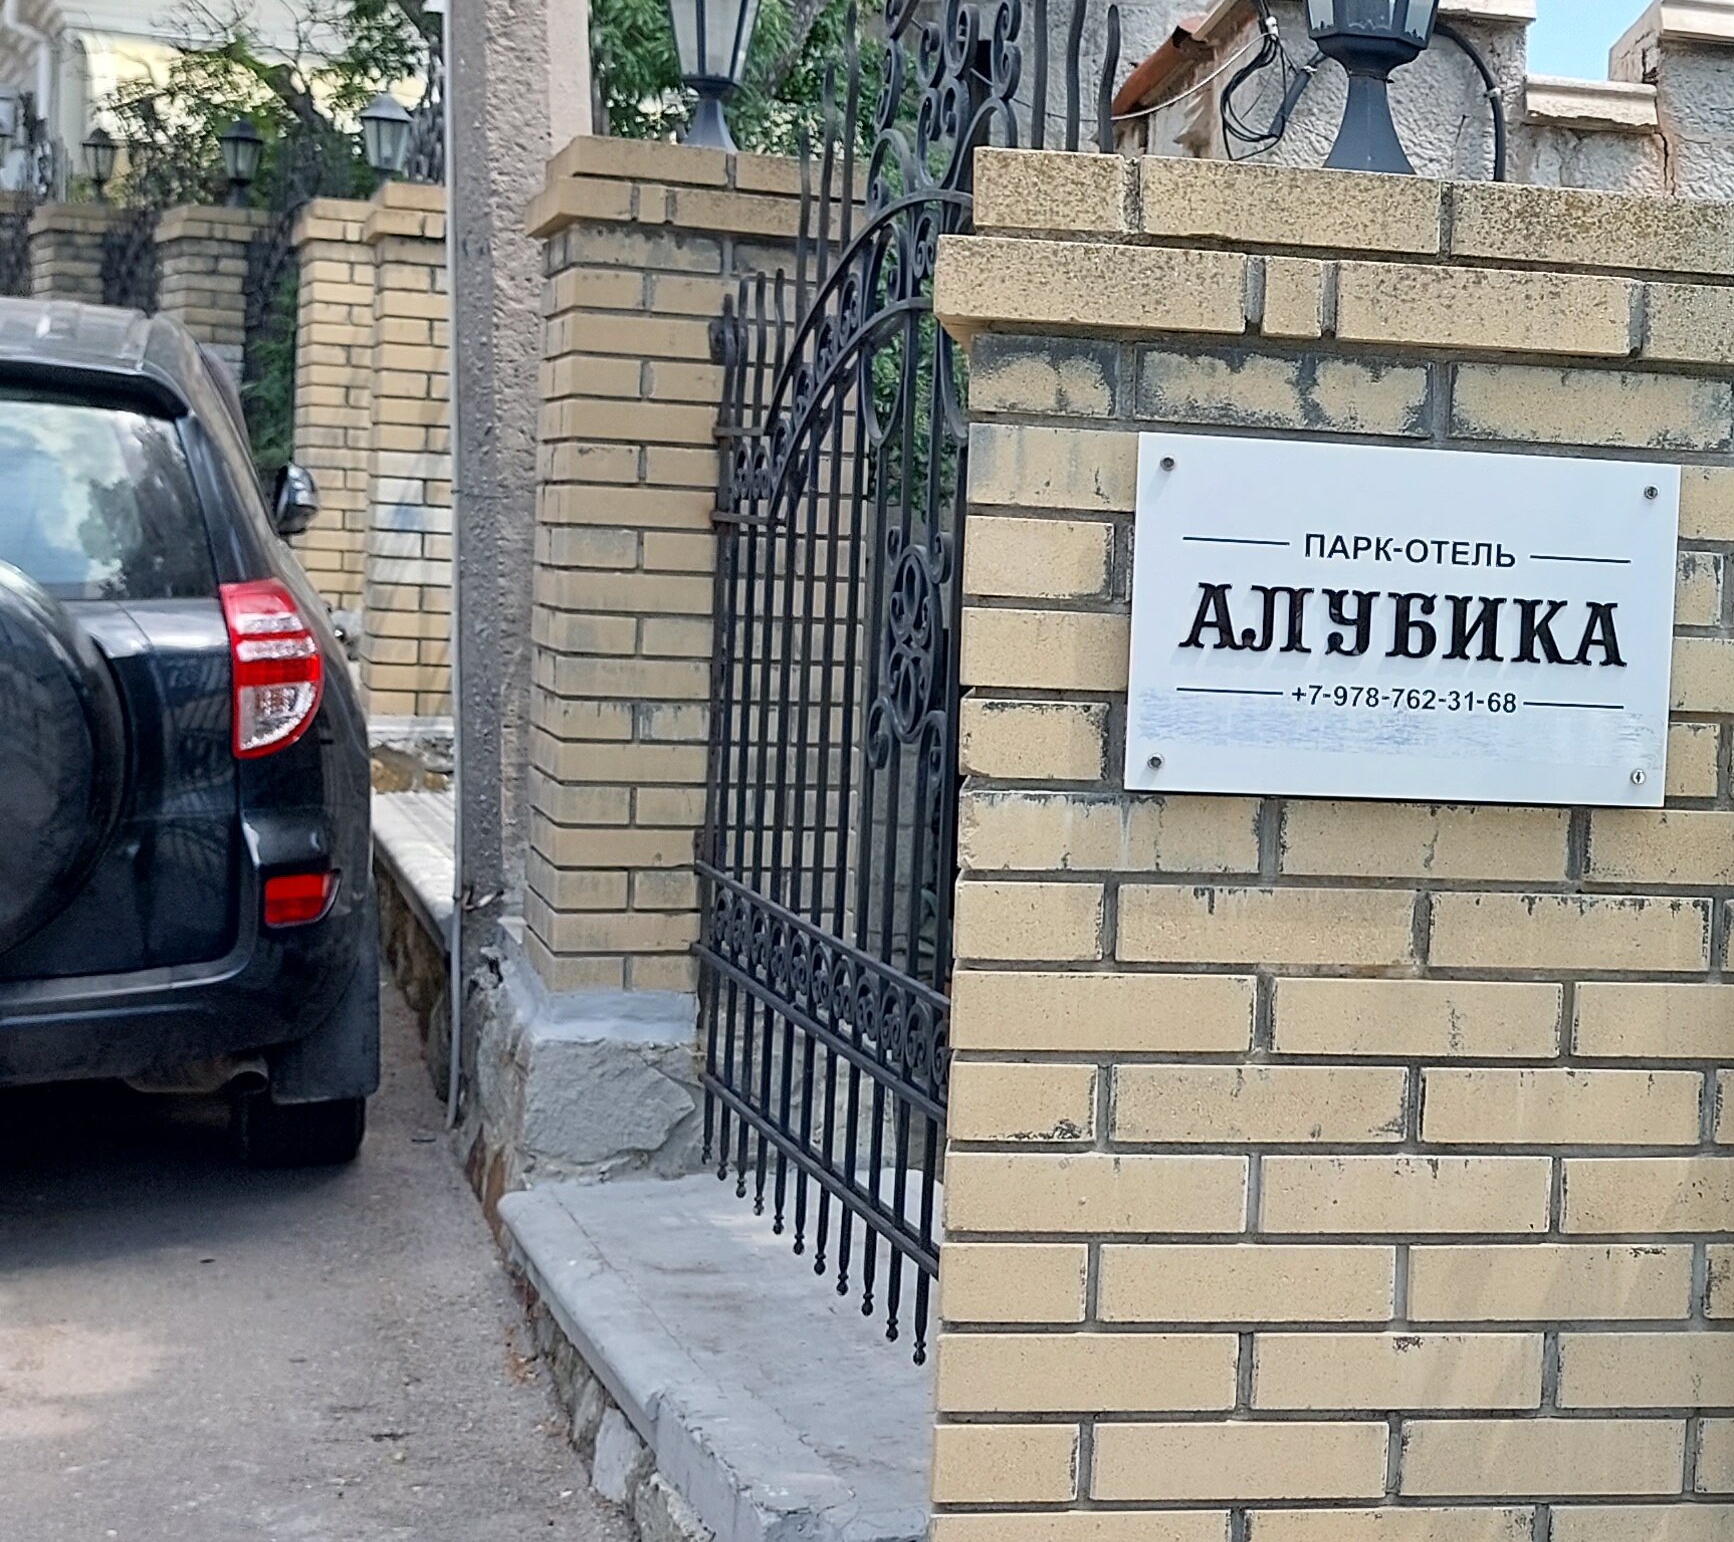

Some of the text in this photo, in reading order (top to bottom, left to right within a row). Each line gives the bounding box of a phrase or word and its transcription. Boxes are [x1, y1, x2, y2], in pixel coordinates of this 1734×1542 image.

[1304, 533, 1516, 567] ПАРК-ОТЕЛЬ
[1179, 582, 1627, 667] АЛУБИКА
[1291, 684, 1517, 713] +7-978-762-31-68
